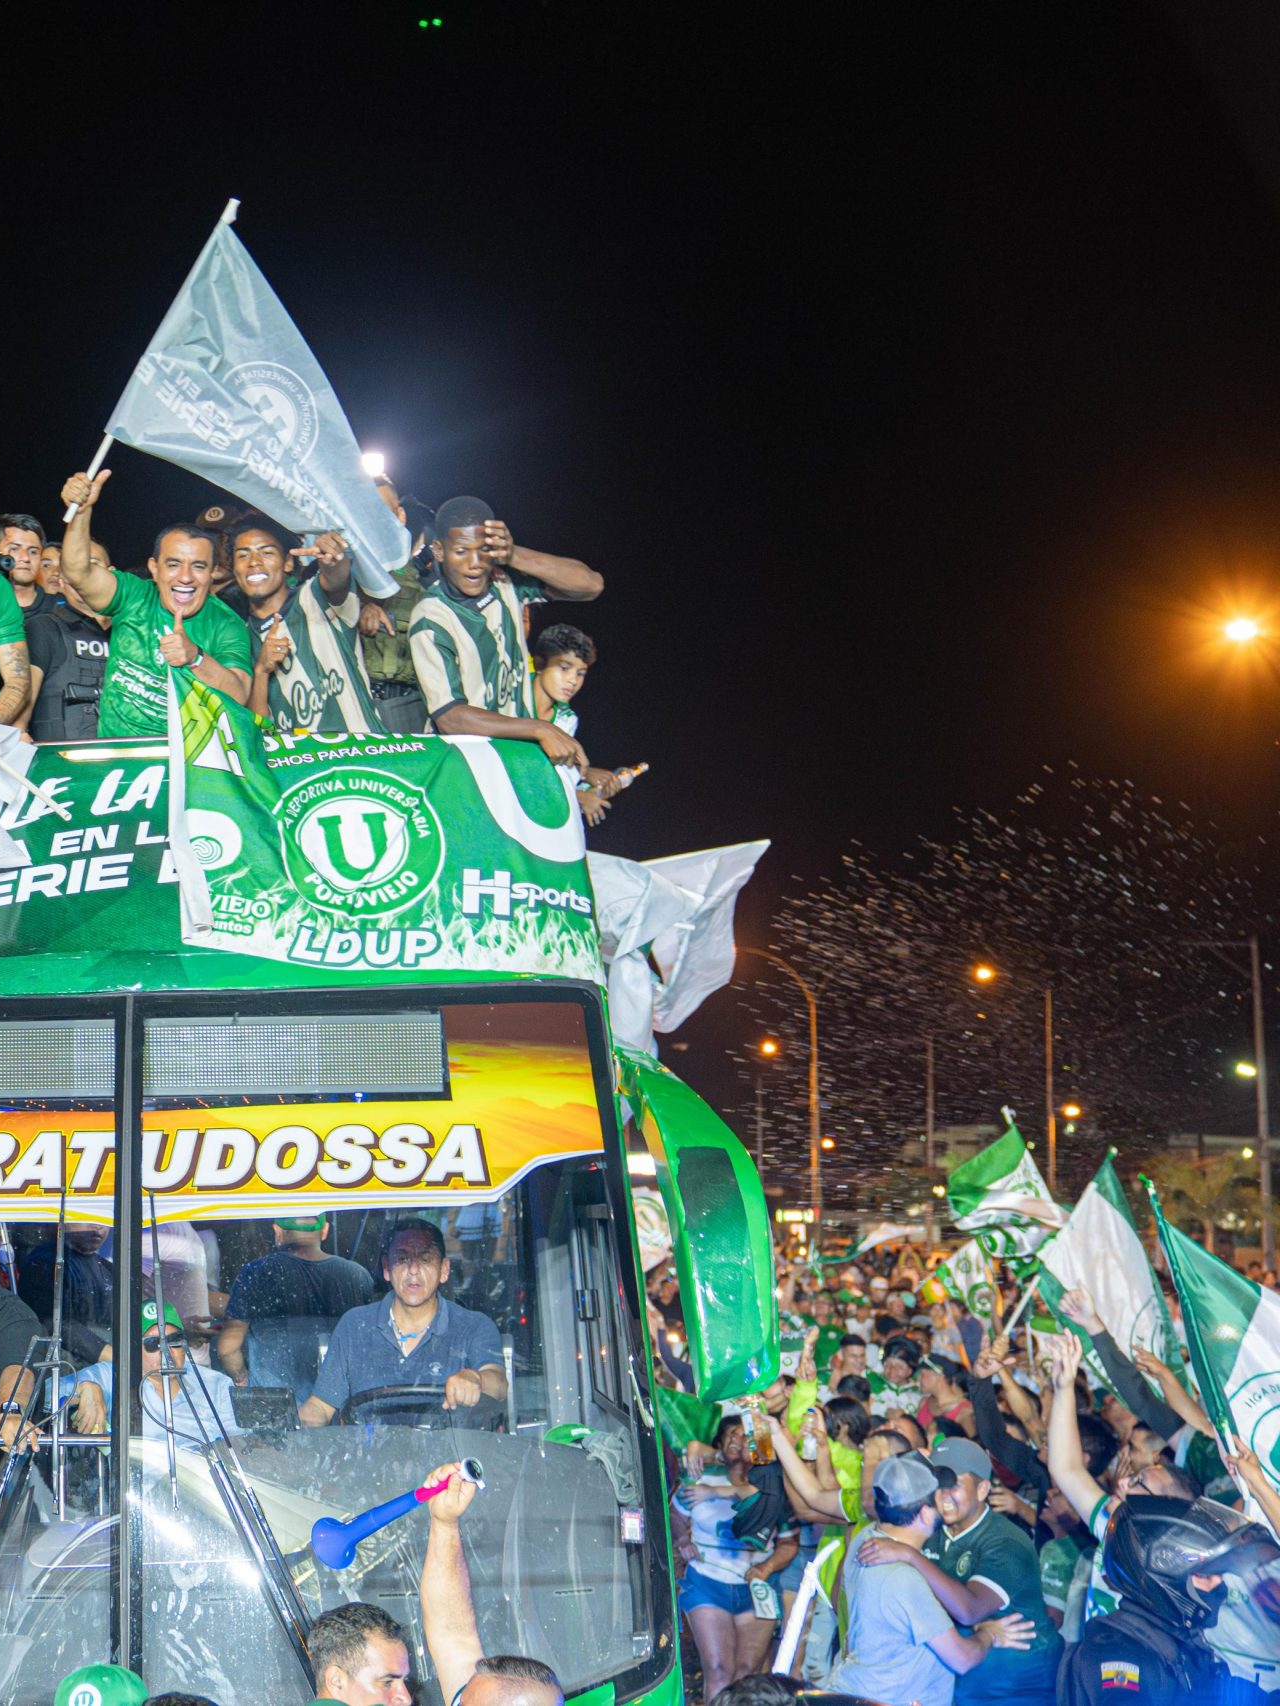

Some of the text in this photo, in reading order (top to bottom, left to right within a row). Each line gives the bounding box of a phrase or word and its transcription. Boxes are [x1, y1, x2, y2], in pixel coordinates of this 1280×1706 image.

[111, 671, 168, 707] PRIME
[267, 753, 315, 769] CHOS
[317, 745, 363, 762] PARA
[364, 741, 426, 757] GANAR
[90, 765, 166, 816] LA
[286, 779, 347, 818] DEPORTIVA
[49, 824, 120, 857] EN
[210, 893, 272, 920] VIEJO
[213, 918, 254, 936] untos
[288, 925, 440, 968] LDUP
